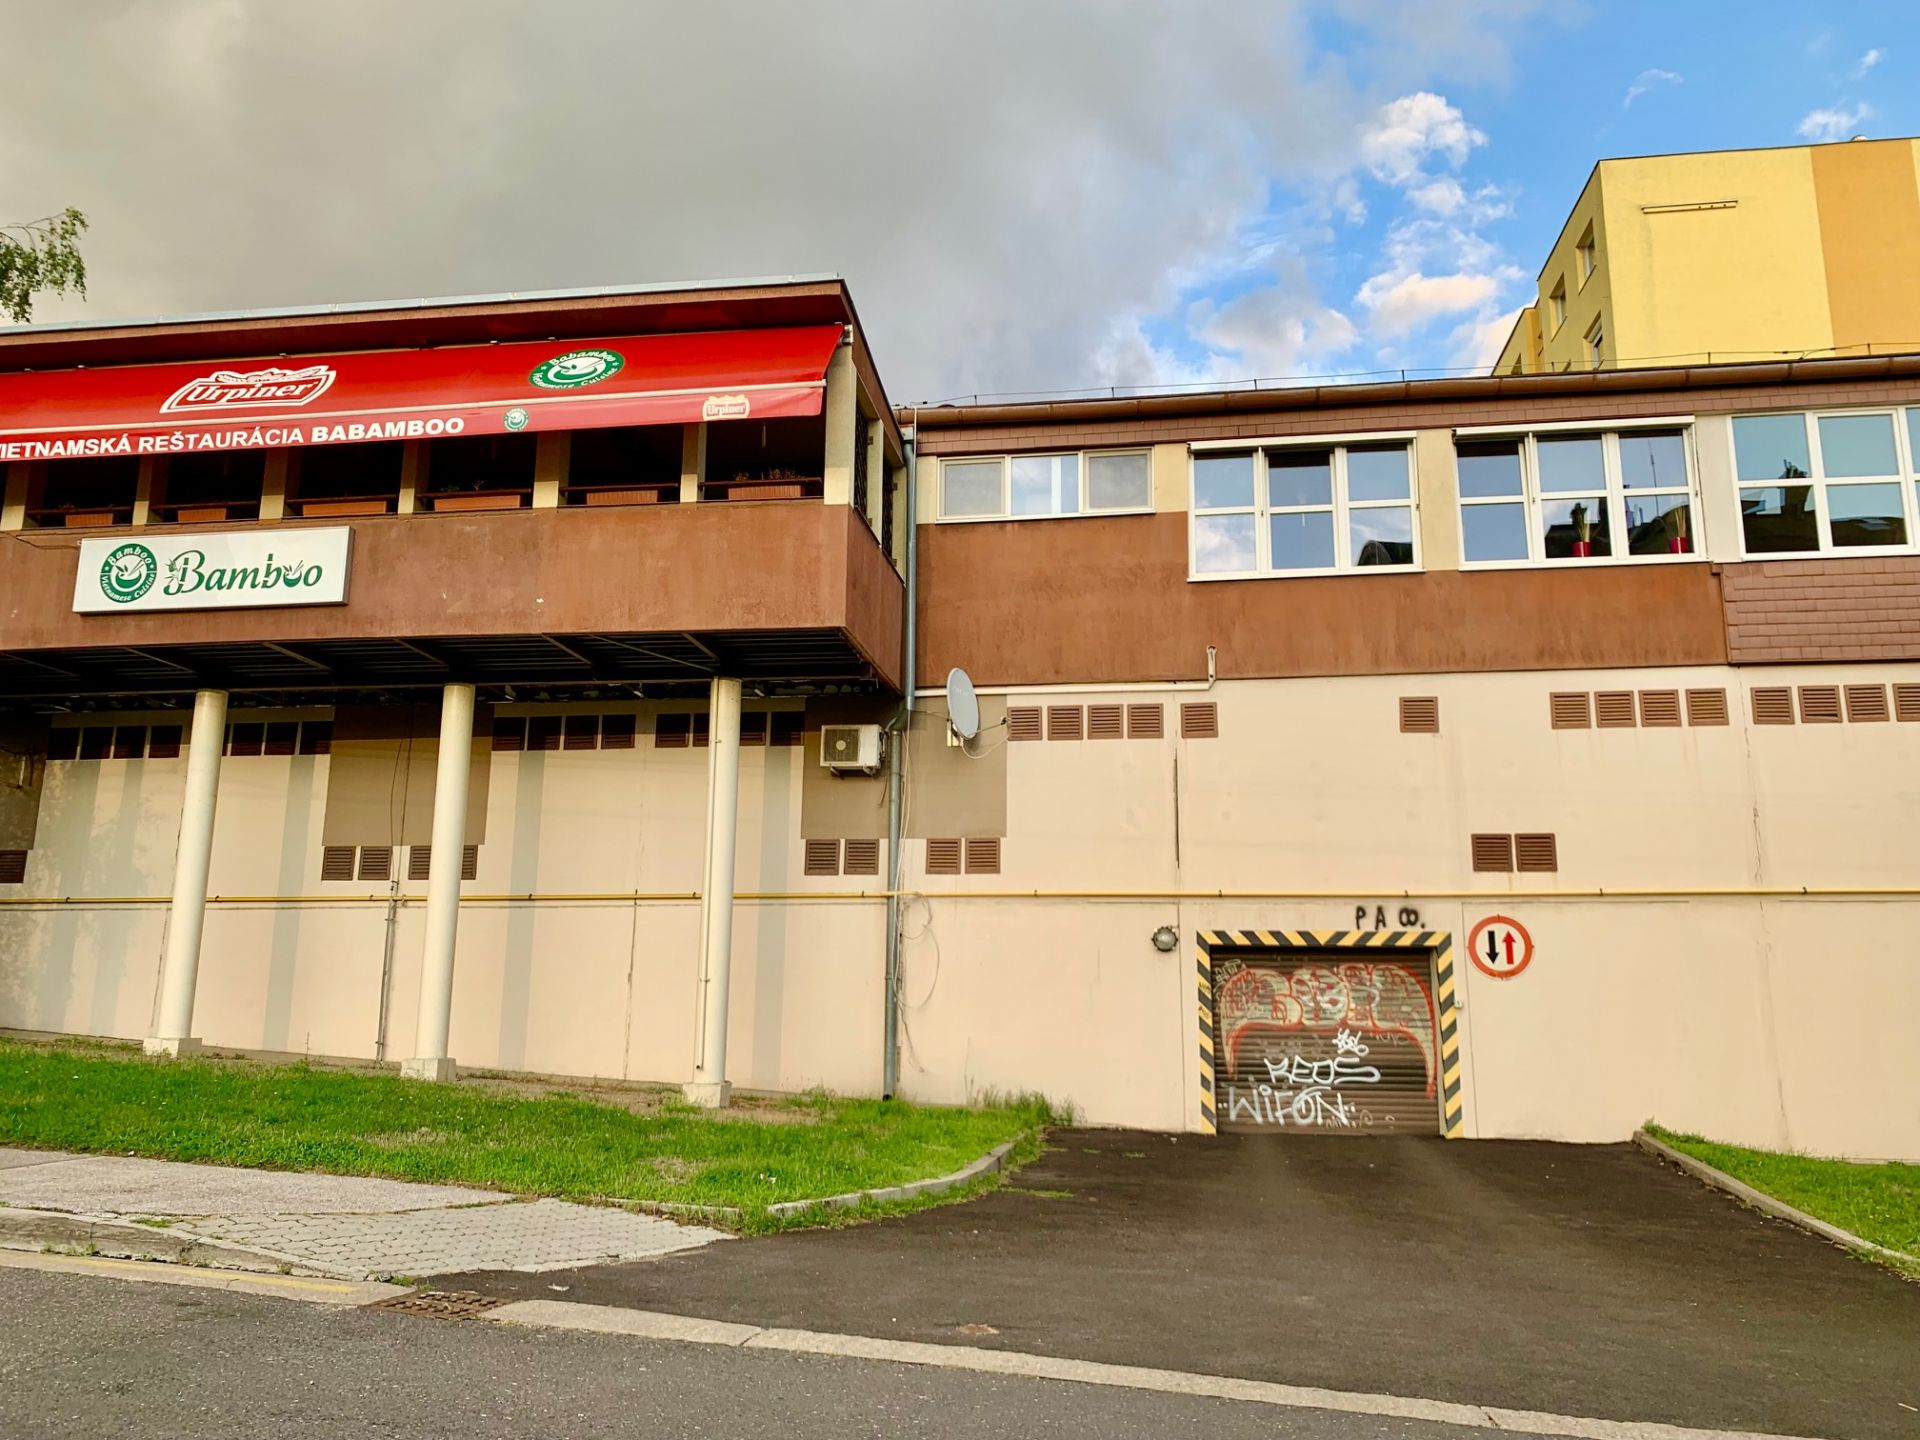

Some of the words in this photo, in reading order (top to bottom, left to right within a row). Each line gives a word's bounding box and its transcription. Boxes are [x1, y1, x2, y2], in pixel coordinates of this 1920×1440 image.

[186, 381, 313, 404] Urpiner
[138, 426, 304, 453] REŠTAURÁCIA
[311, 417, 465, 443] BABAMBOO
[107, 546, 152, 566] Bamboo
[163, 549, 323, 596] Bamboo
